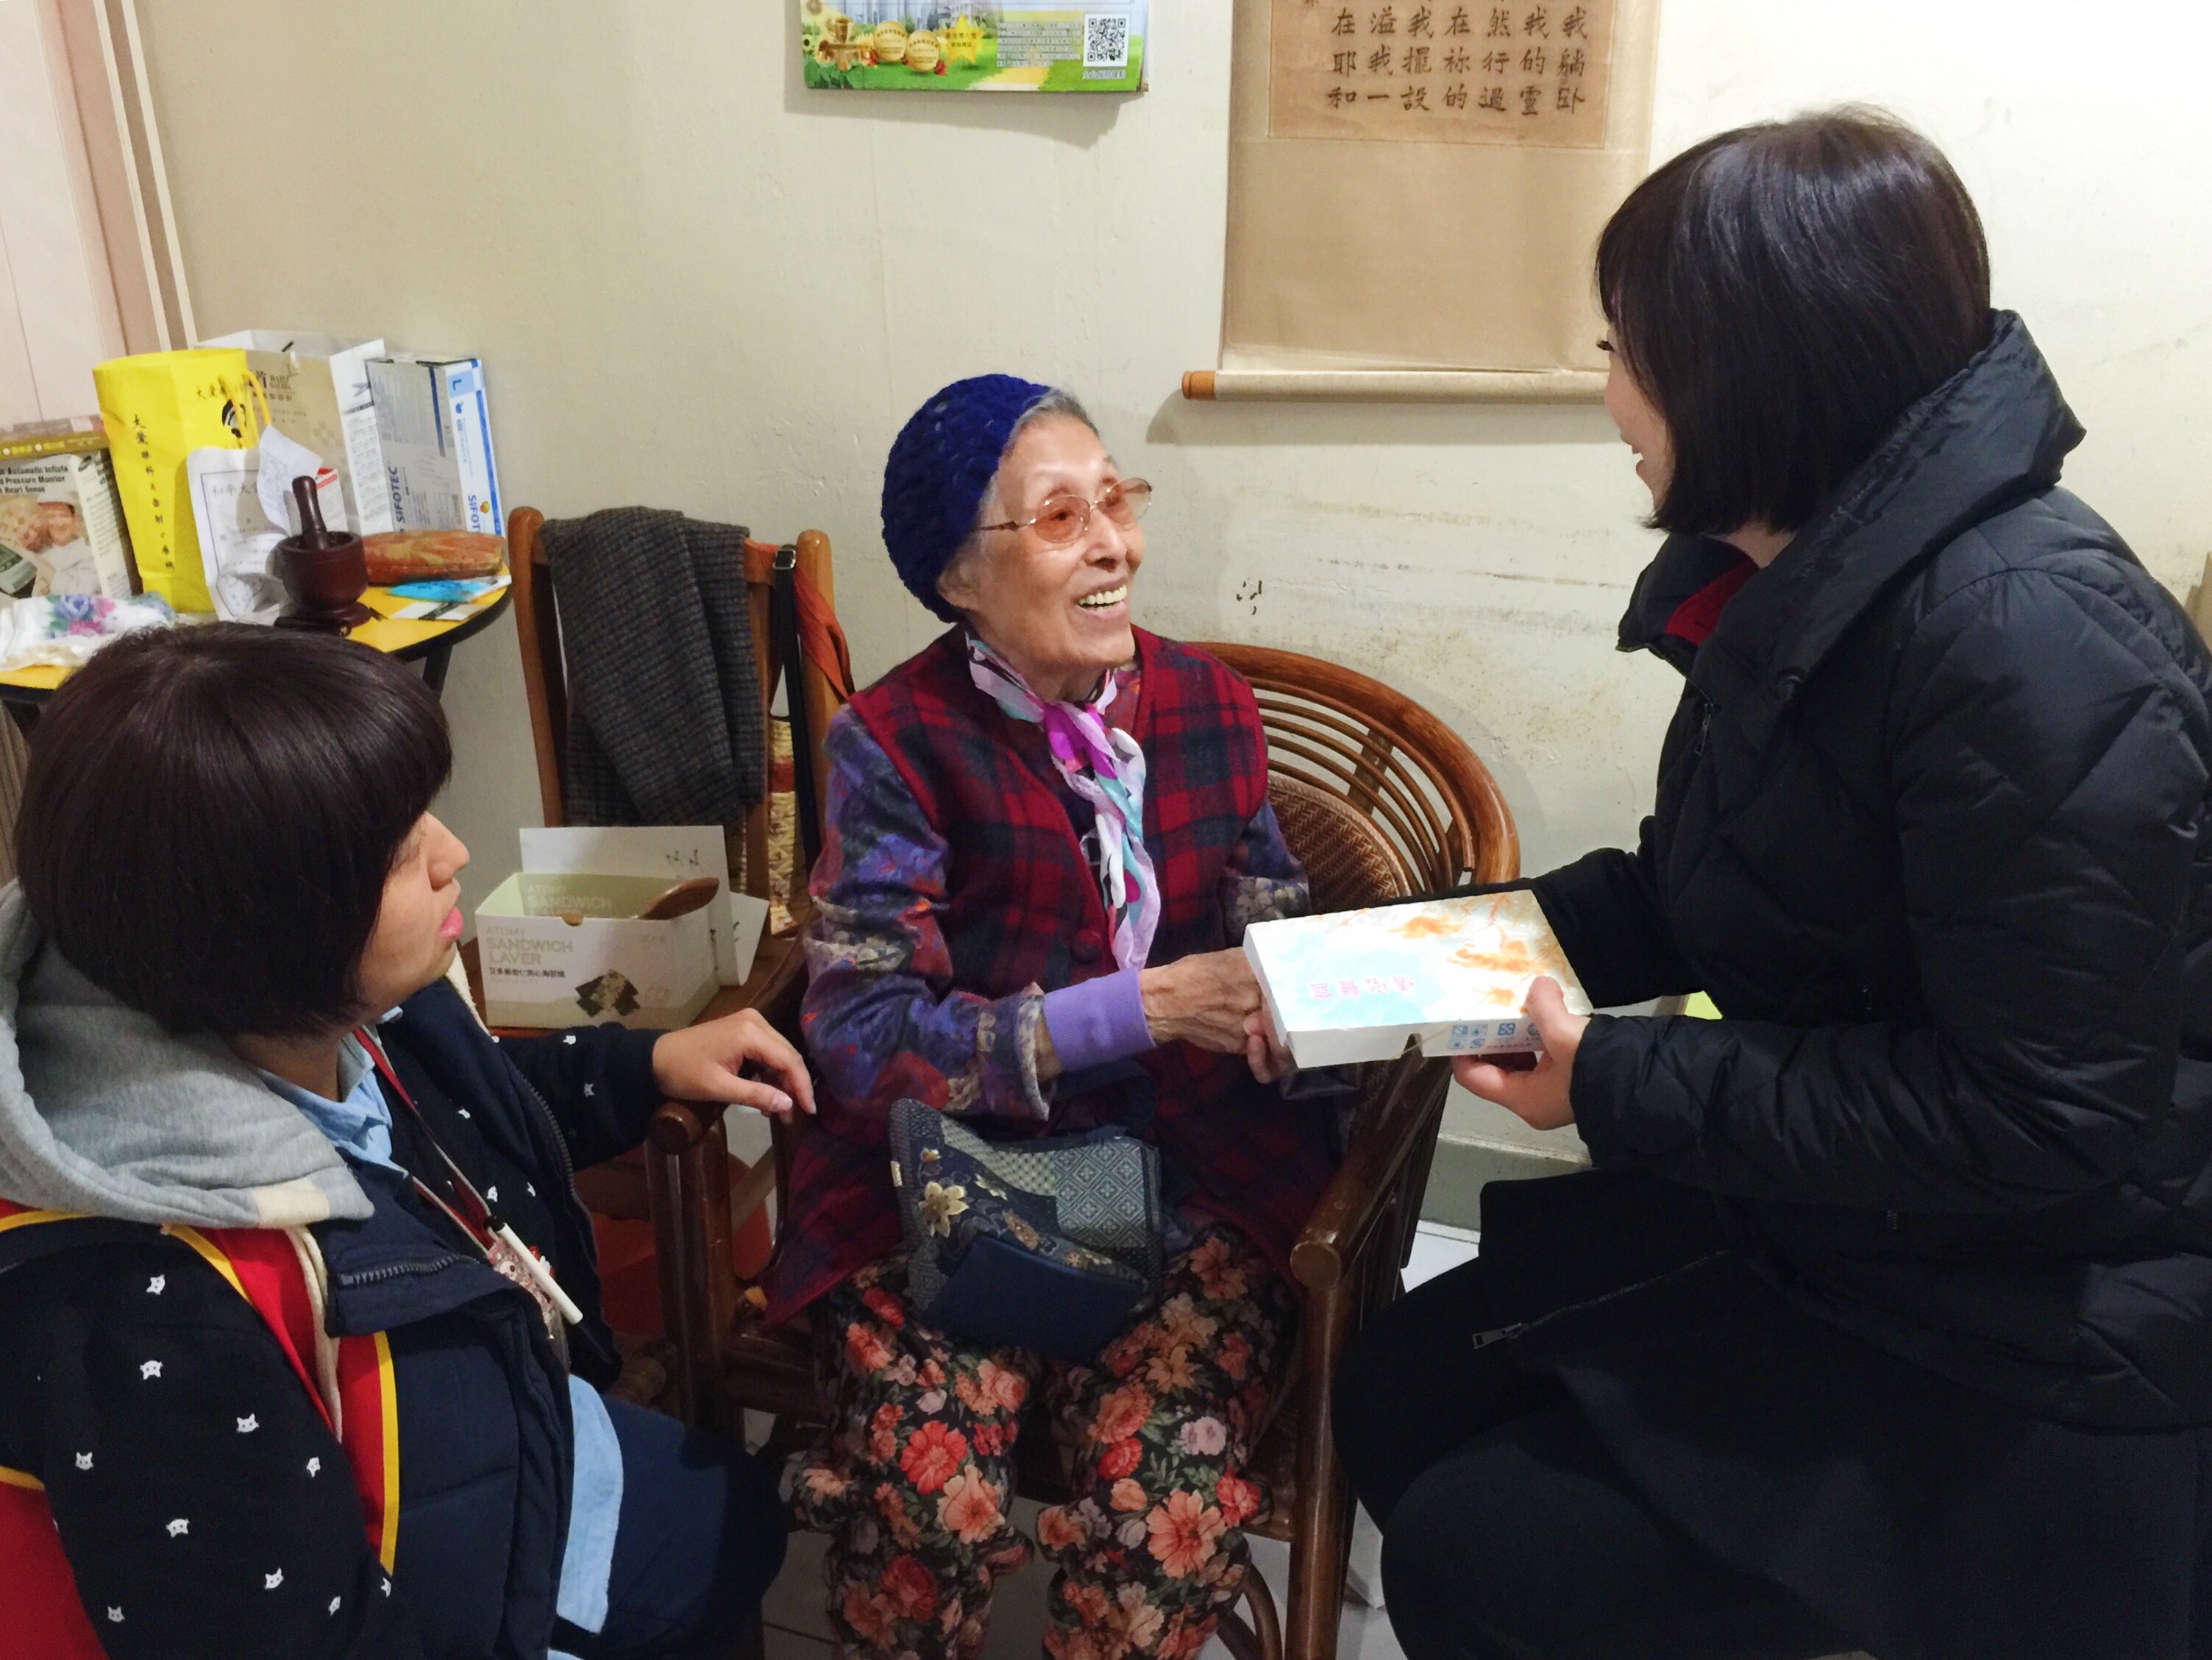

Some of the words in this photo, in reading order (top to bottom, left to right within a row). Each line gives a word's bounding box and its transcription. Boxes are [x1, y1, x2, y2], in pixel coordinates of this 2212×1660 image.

[452, 379, 462, 391] L
[388, 466, 405, 523] SIFOTEC
[486, 937, 573, 953] SANDWICH
[488, 951, 542, 965] LAVER
